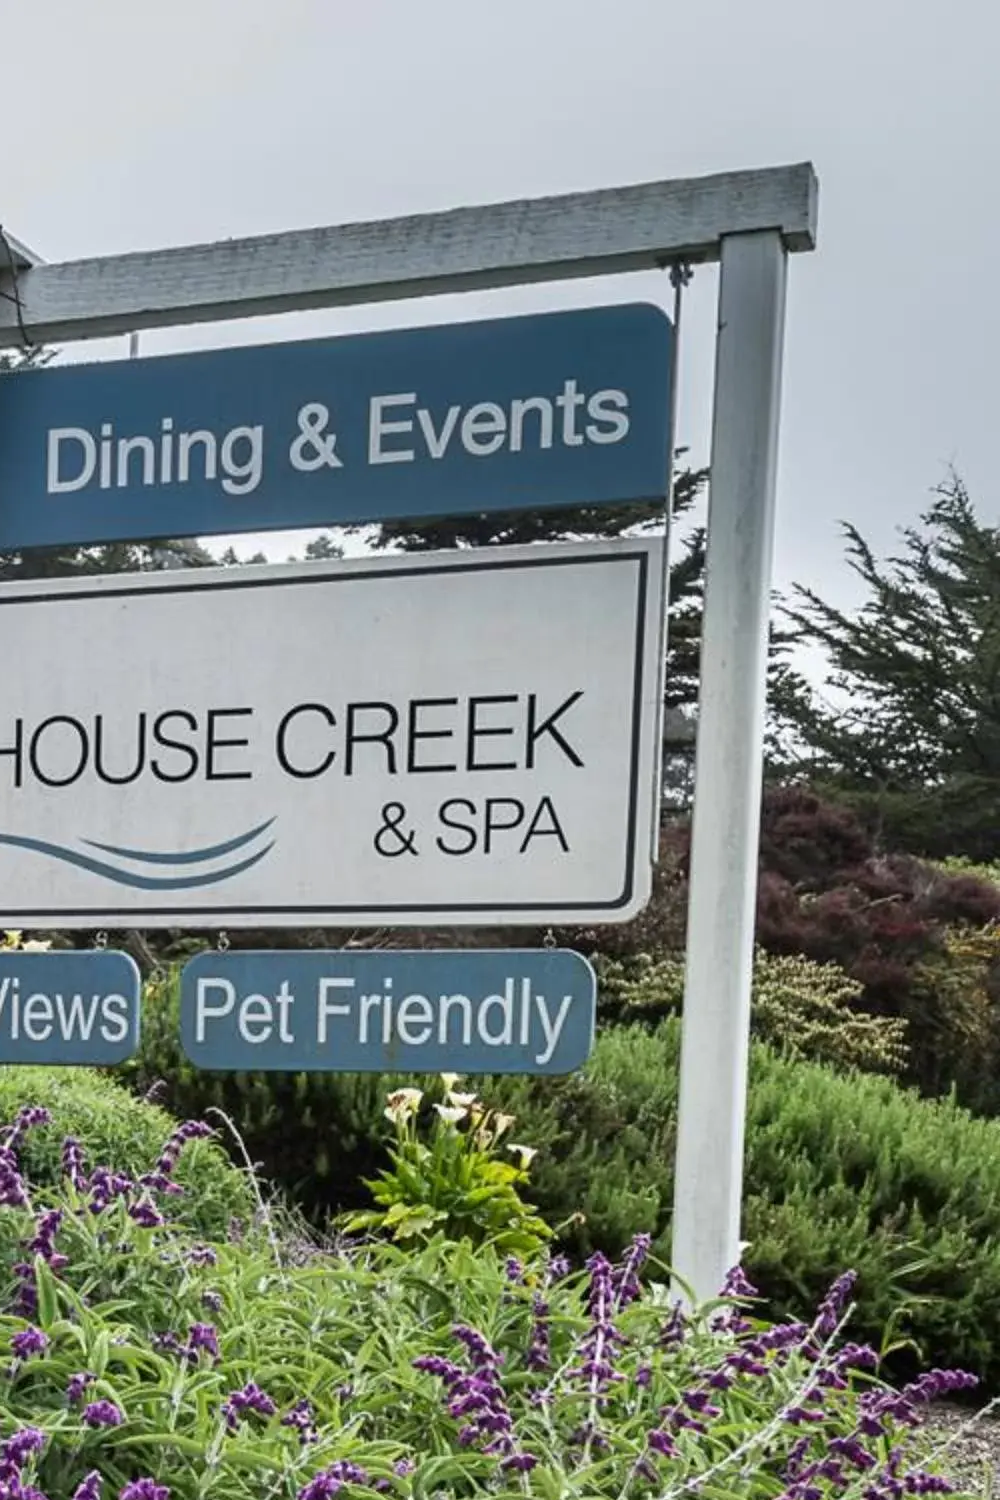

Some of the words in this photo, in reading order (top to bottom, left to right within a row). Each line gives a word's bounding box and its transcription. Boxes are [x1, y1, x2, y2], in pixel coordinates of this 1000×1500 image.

[47, 417, 263, 494] Dining
[289, 403, 343, 471] &
[367, 379, 629, 465] Events
[276, 690, 585, 778] CREEK
[373, 801, 418, 857] &
[436, 796, 569, 856] SPA
[195, 977, 295, 1043] Pet
[318, 977, 572, 1064] Friendly
